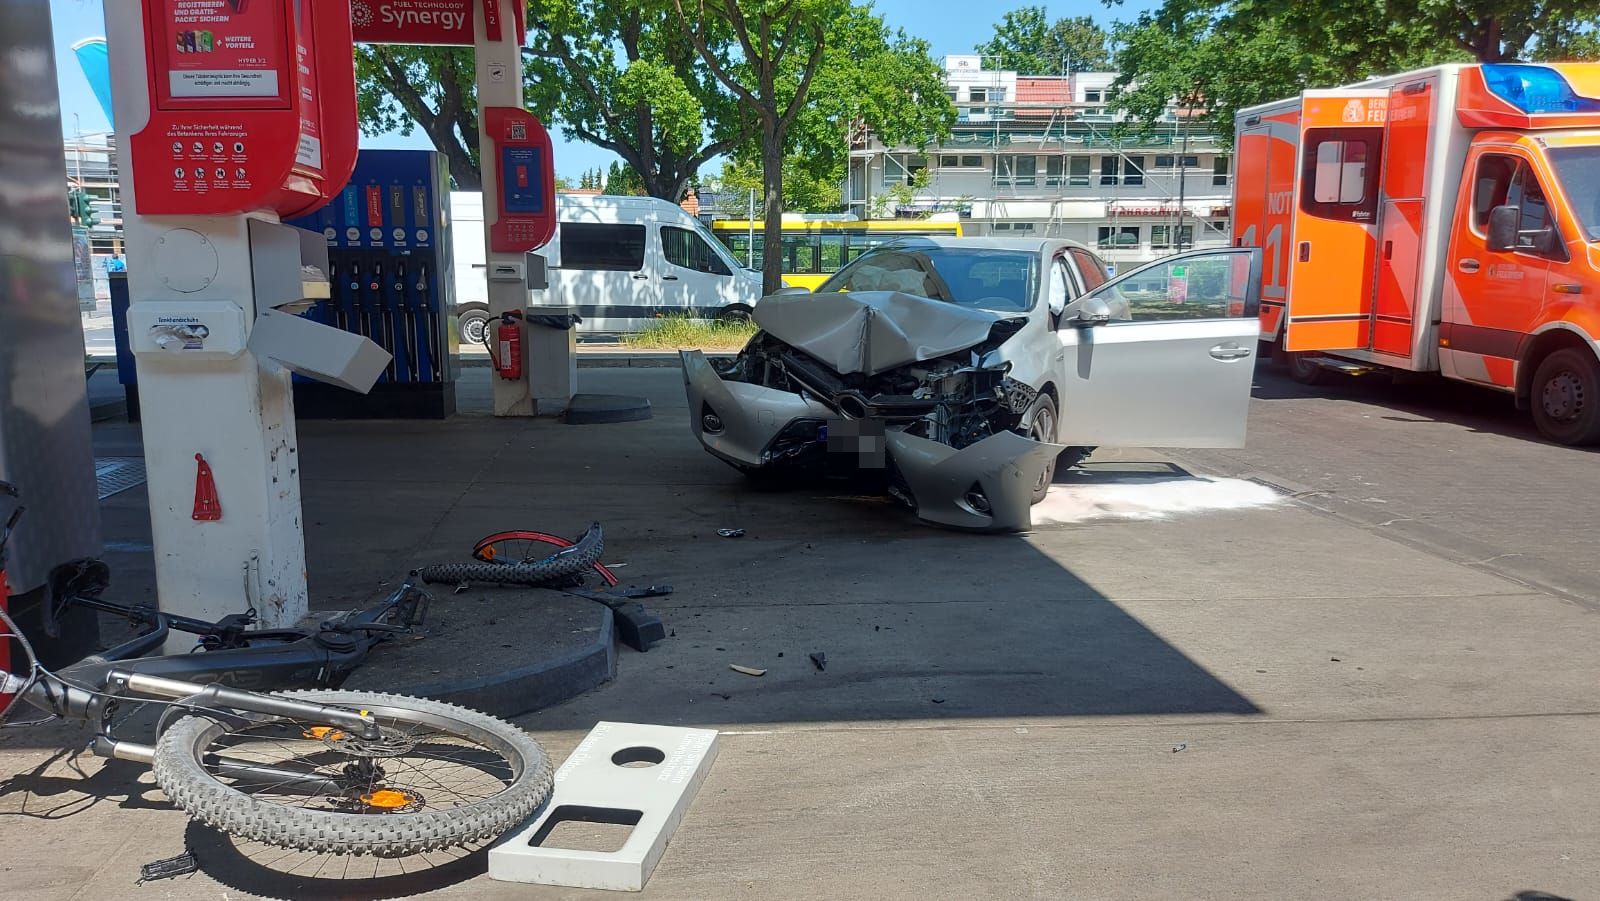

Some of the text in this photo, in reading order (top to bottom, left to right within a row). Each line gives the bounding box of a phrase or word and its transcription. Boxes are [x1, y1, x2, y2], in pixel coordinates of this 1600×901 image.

[414, 1, 464, 9] TECHNOLOGY
[488, 0, 493, 8] 1
[380, 5, 465, 30] Synergy
[490, 16, 496, 25] 2
[1268, 192, 1292, 215] NOT
[1112, 207, 1185, 217] FAHRSCHUL
